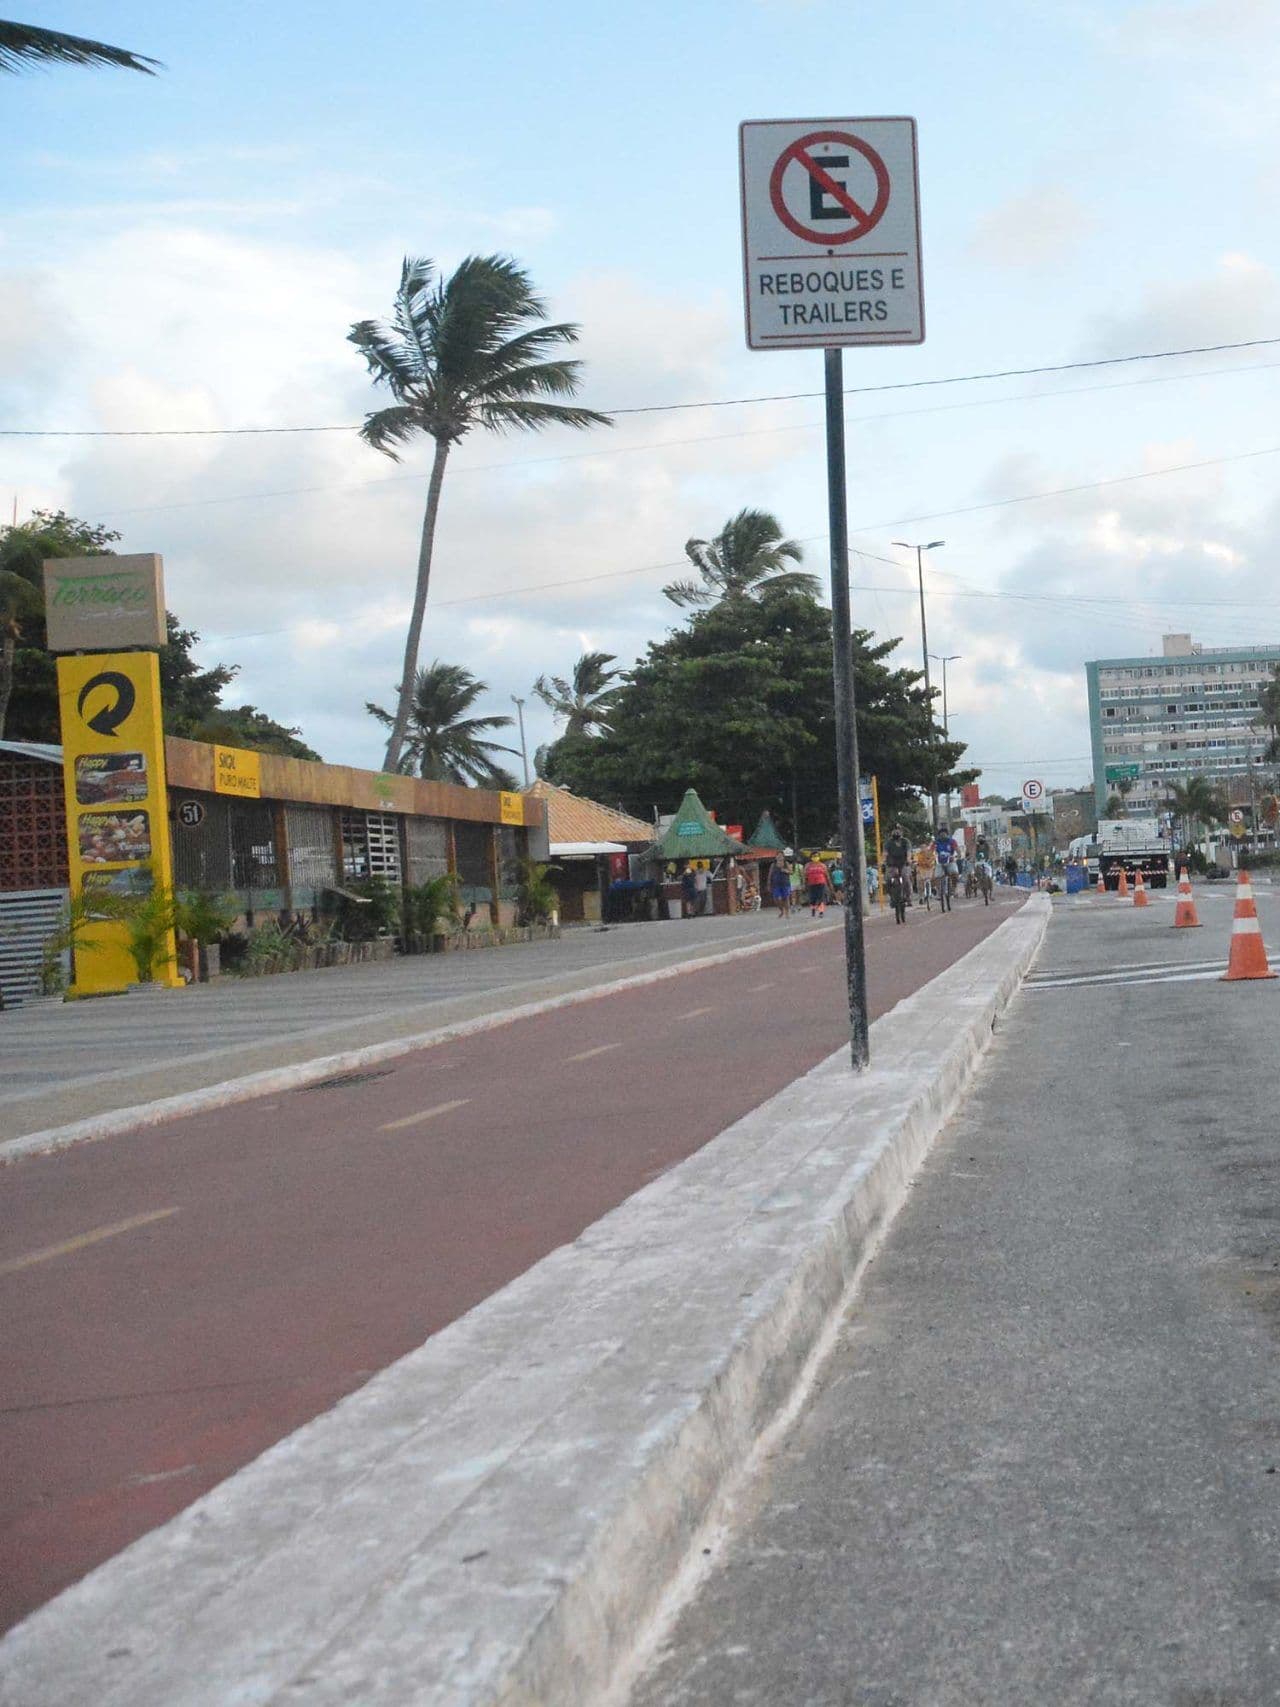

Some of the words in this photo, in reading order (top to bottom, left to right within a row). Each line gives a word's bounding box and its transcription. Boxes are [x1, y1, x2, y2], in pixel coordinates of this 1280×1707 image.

[809, 155, 852, 220] E
[760, 269, 884, 294] REBOQUES
[891, 268, 905, 289] E
[779, 300, 888, 325] TRAILERS
[1029, 784, 1036, 795] E
[183, 805, 199, 823] 51
